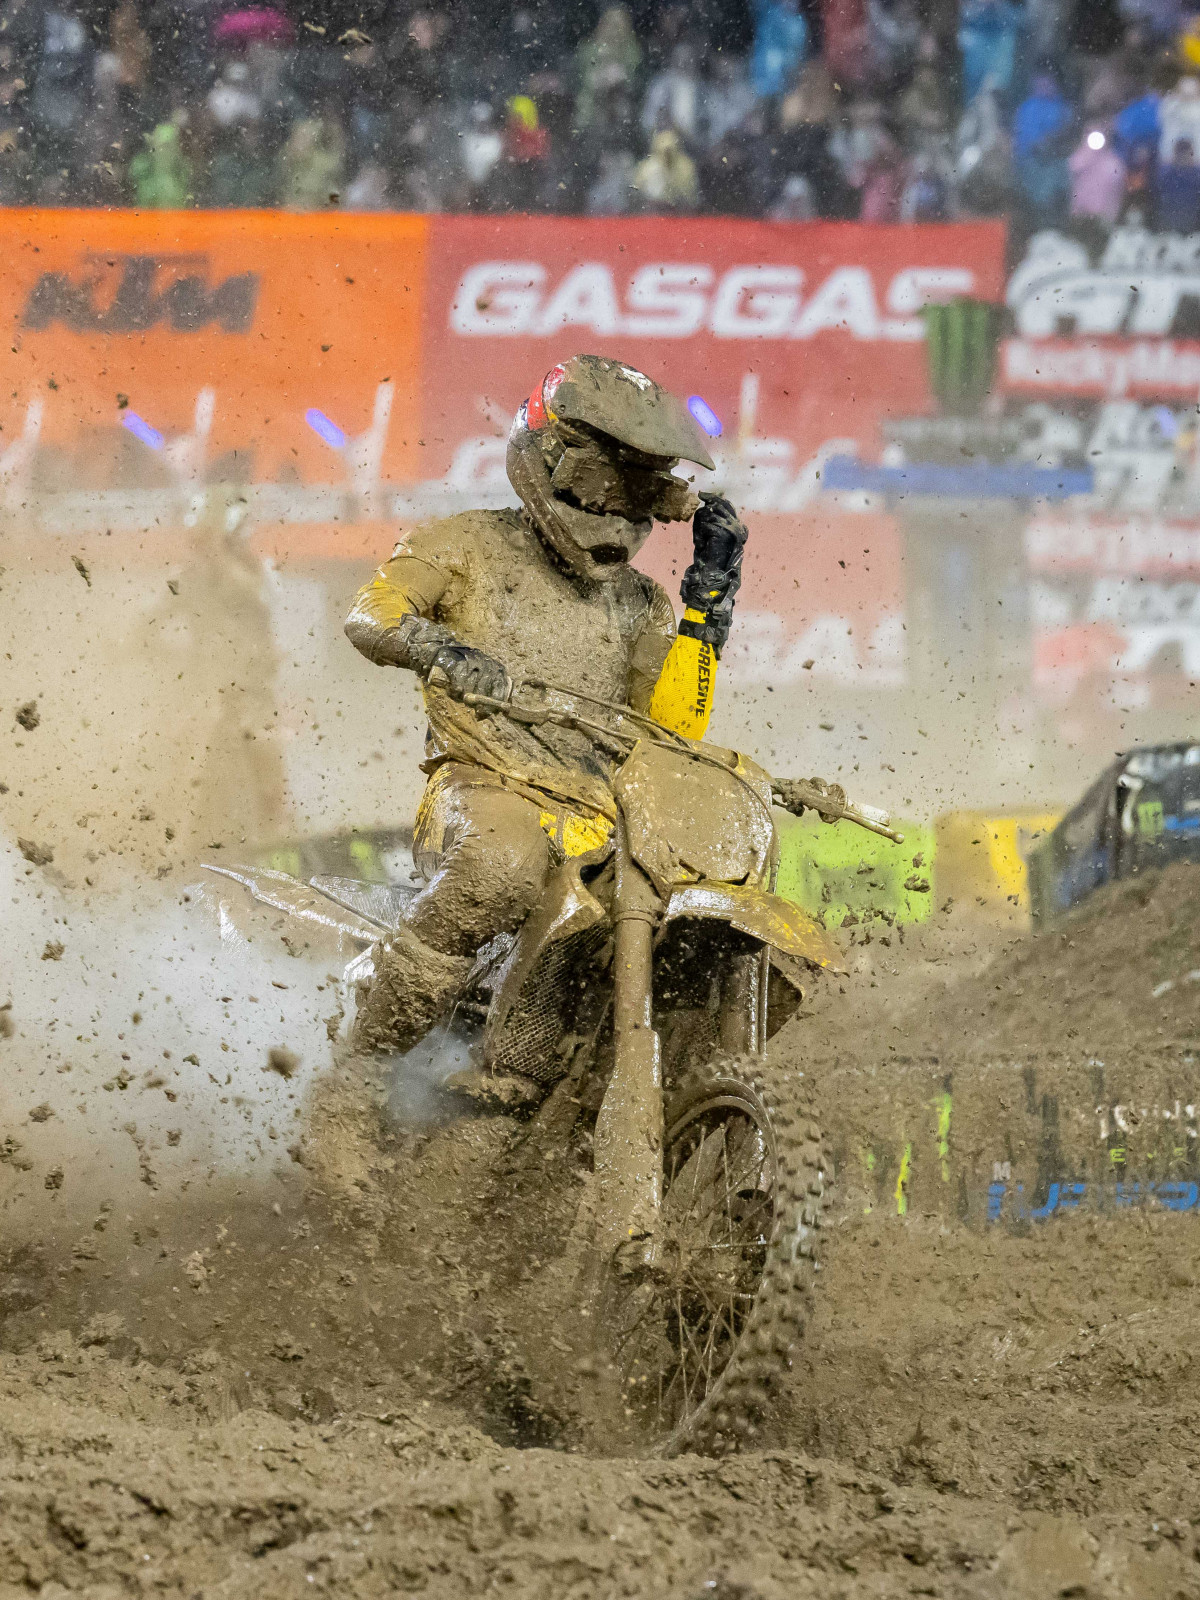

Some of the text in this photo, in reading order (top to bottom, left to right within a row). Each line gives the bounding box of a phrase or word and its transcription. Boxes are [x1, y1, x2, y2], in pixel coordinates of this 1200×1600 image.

[18, 251, 261, 334] KTM
[450, 260, 974, 340] GASGAS
[695, 640, 711, 719] GRESSIVE
